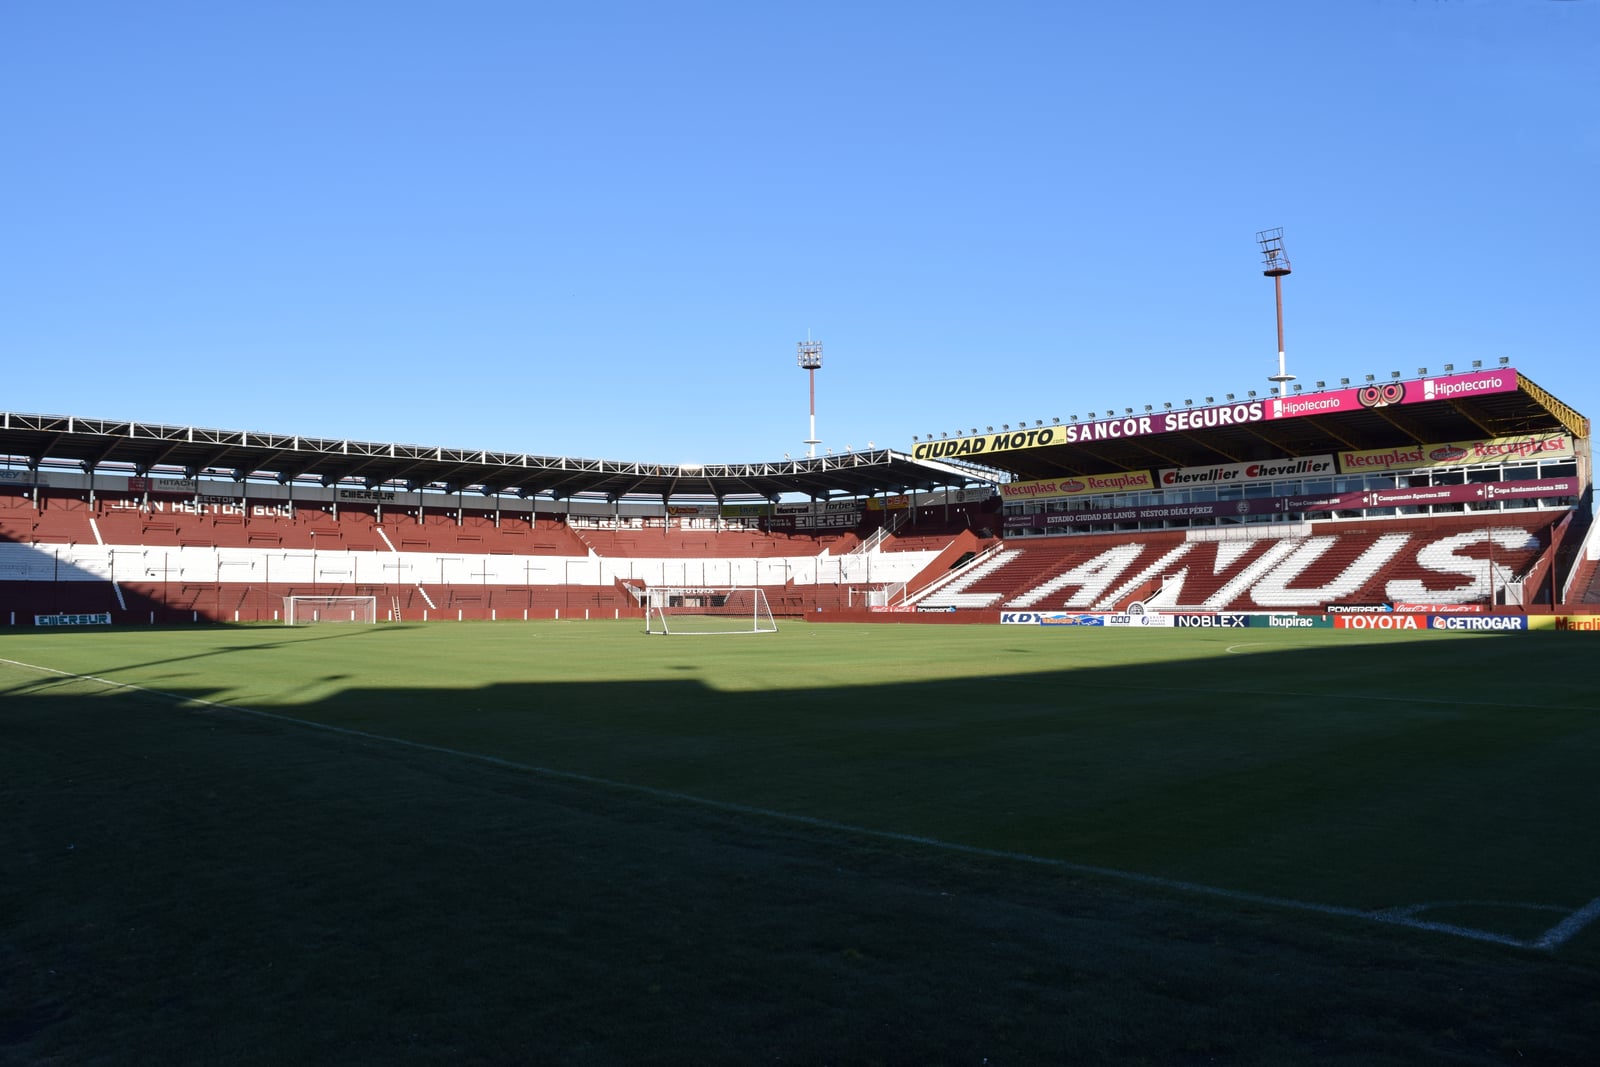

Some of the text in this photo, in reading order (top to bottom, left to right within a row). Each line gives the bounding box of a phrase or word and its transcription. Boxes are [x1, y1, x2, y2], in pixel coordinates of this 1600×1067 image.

[1435, 376, 1503, 396] Hipotecario
[1282, 397, 1340, 414] Hipotecario
[1066, 403, 1263, 442] SANCOR SEGUROS
[914, 429, 1054, 460] CIUDAD MOTO
[1473, 437, 1565, 457] Recuplast
[1344, 450, 1425, 467] Recuplast
[1163, 460, 1330, 484] Chevallier Chevallier
[1003, 482, 1057, 496] Recuplast
[1088, 473, 1149, 489] Recuplast
[1047, 505, 1213, 523] ESTADIO CIUDAD DE LANÚS NÉSTOR DÍAZ PÉREZ
[916, 527, 1541, 607] LANUS
[1178, 615, 1245, 627] NOBLEX
[1269, 616, 1312, 628] Ibupirac
[1341, 615, 1418, 629] TOYOTA
[1447, 617, 1521, 629] CETROGAR
